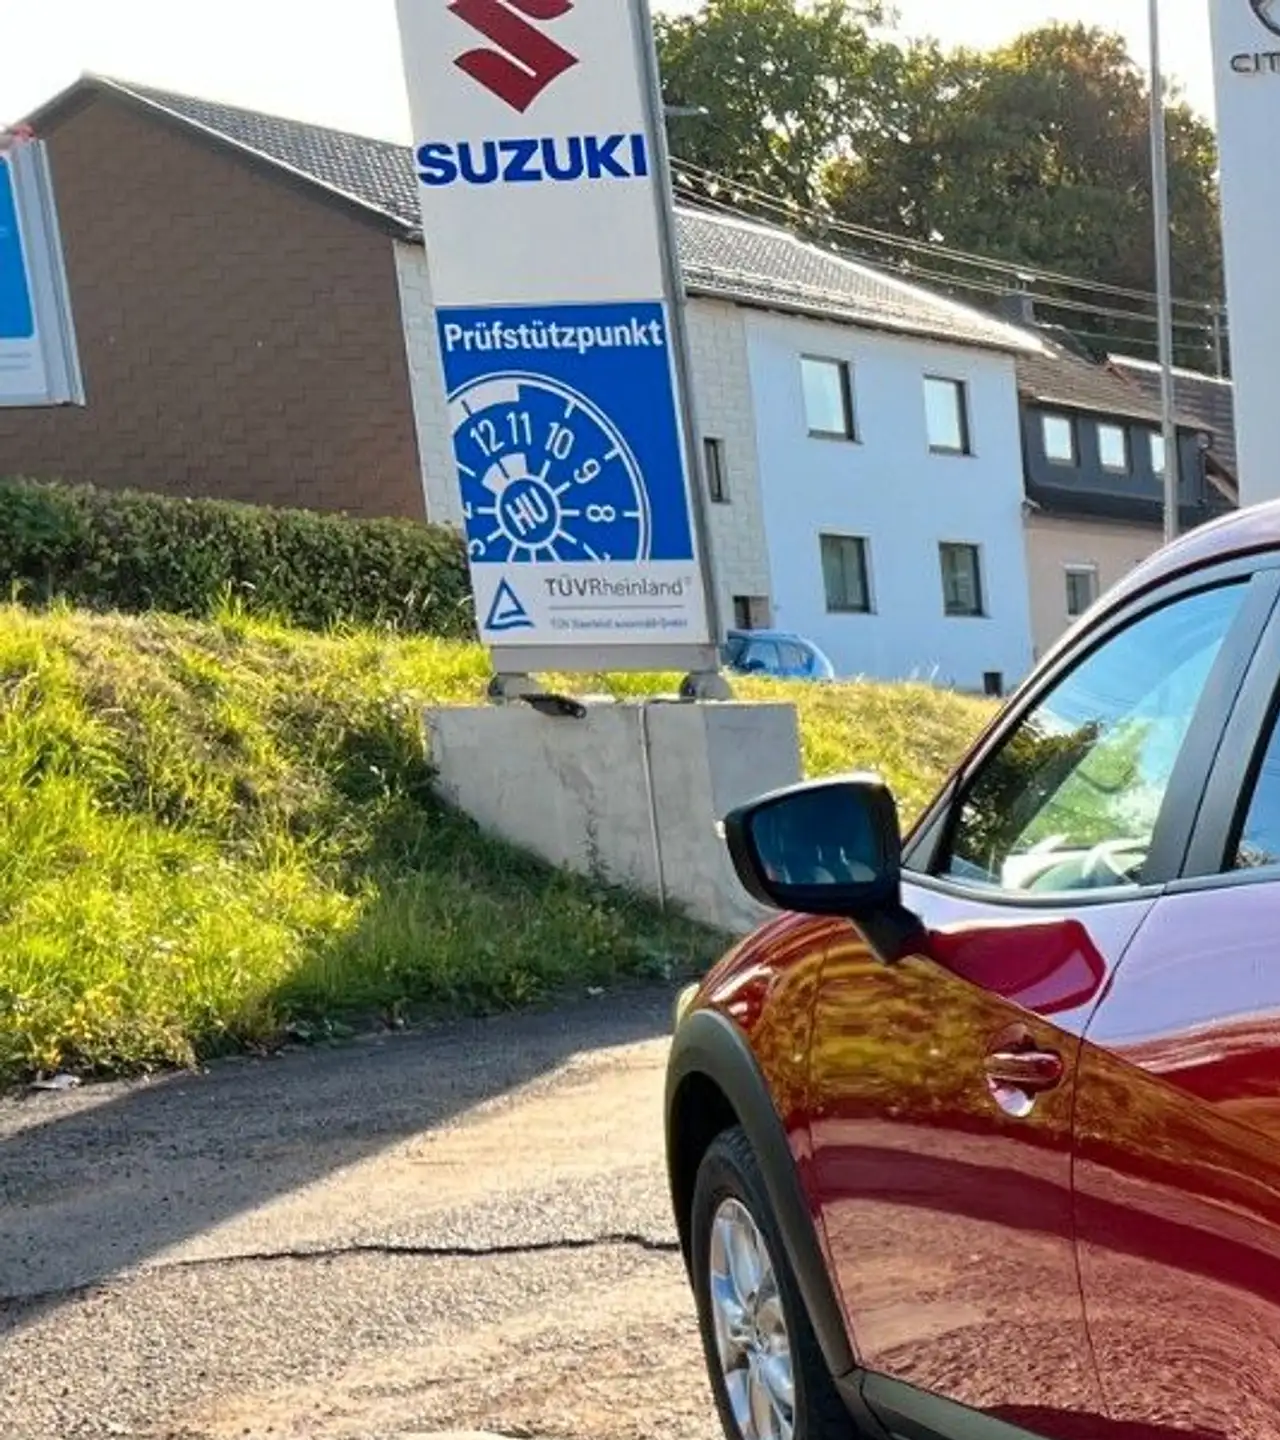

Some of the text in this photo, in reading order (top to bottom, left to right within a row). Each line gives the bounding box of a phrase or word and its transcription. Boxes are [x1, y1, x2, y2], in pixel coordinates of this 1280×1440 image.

[417, 134, 648, 185] SUZUKI
[444, 318, 663, 354] Prüfstützpunkt
[471, 419, 504, 456] 12
[506, 411, 531, 446] 11
[545, 422, 575, 460] 10
[573, 458, 601, 484] 9
[506, 487, 548, 536] HU
[586, 504, 616, 523] 8
